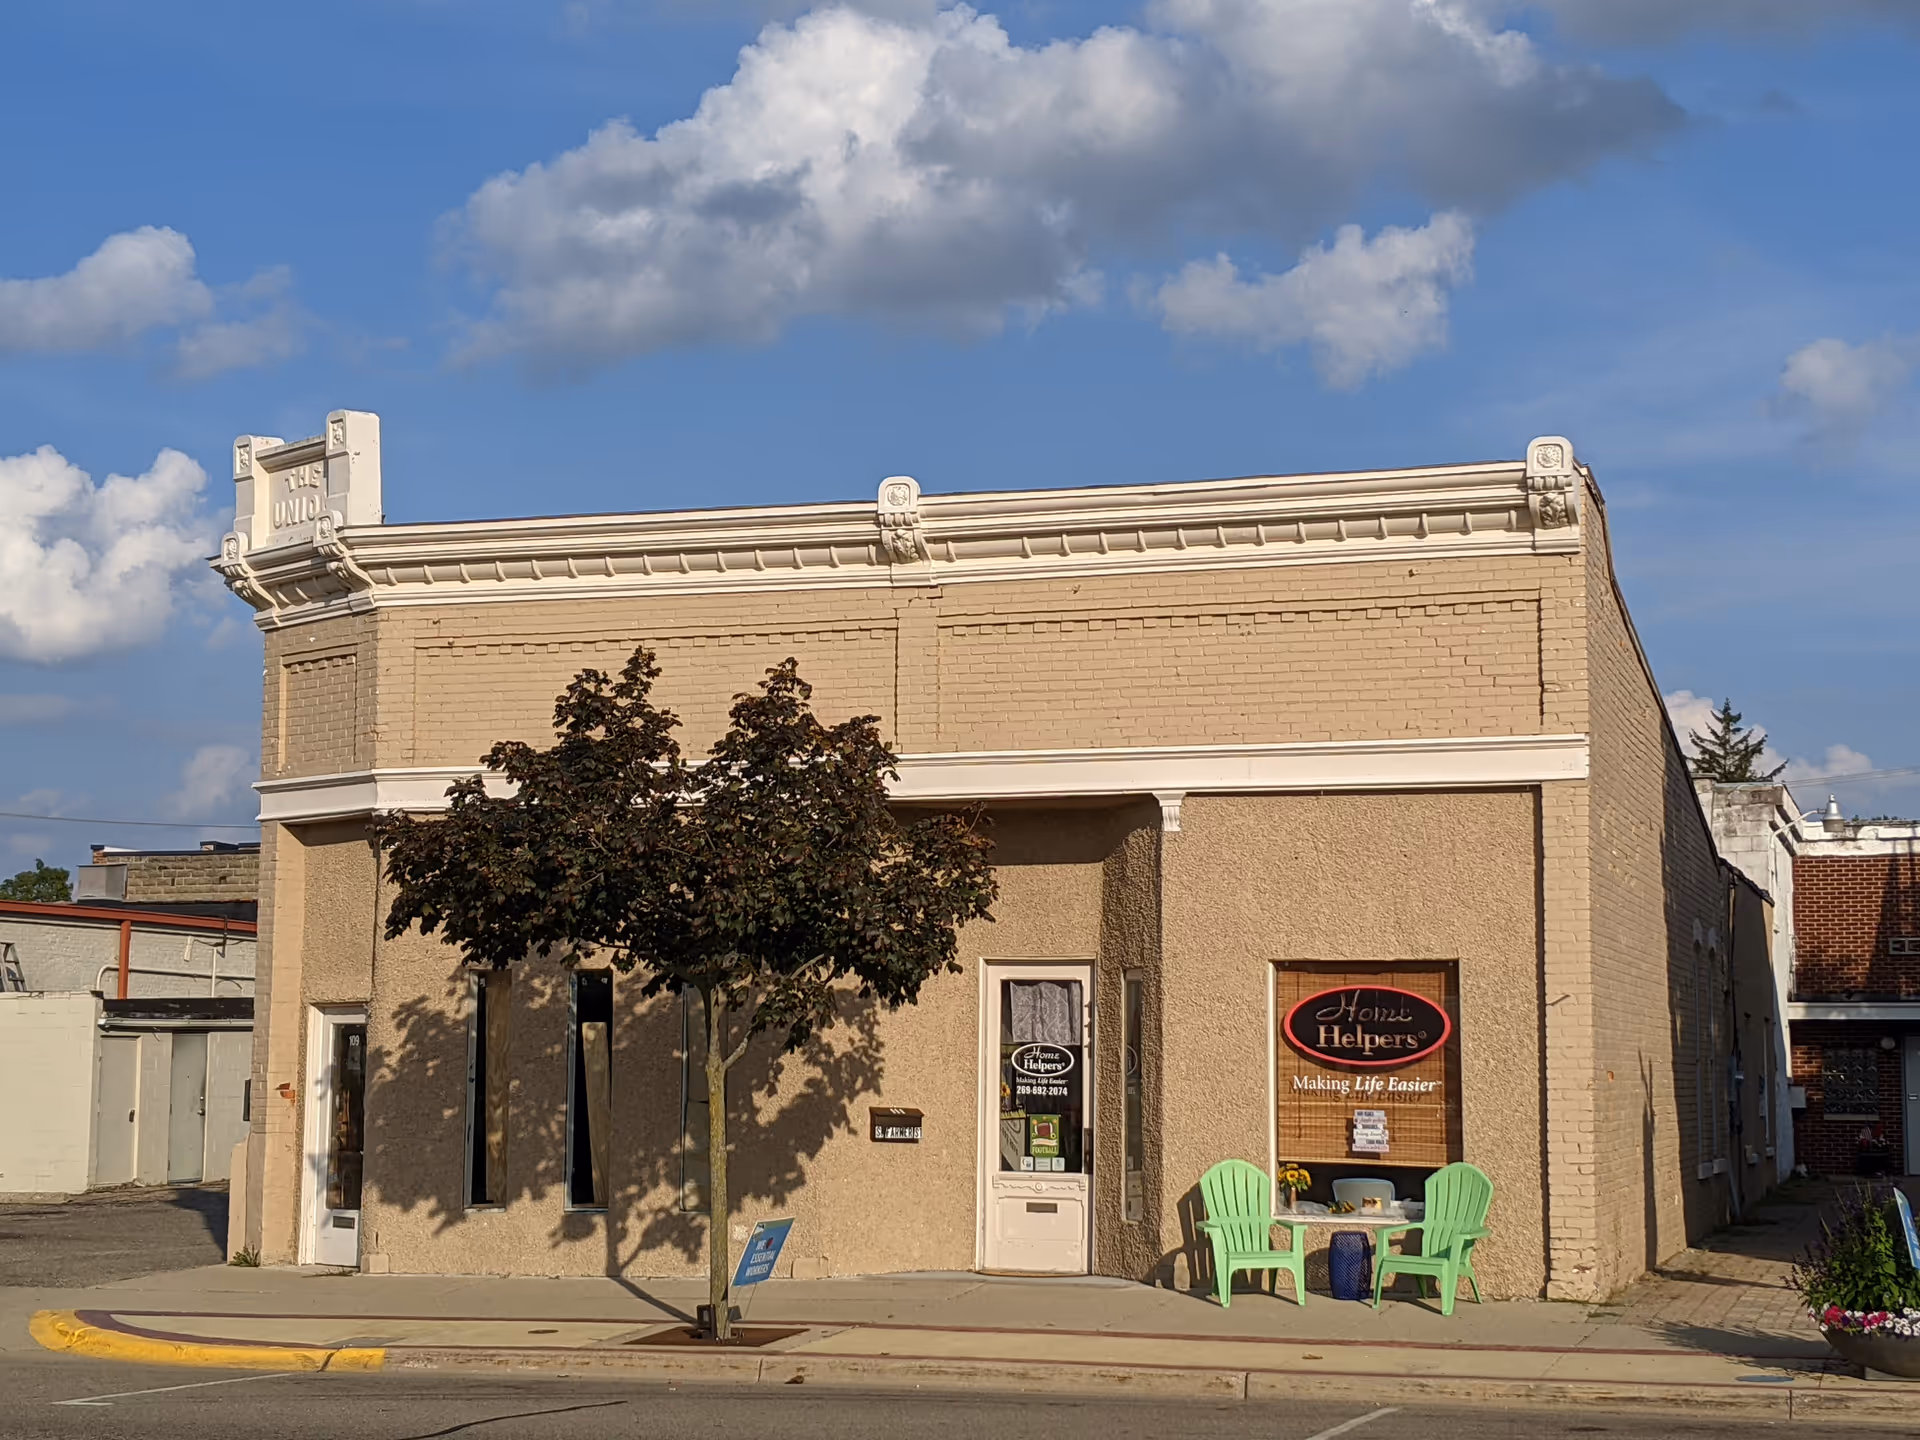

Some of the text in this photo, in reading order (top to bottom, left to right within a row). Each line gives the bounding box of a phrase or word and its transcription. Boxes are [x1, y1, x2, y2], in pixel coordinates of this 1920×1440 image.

[285, 465, 323, 493] THE
[273, 492, 327, 529] UNIO
[349, 1035, 360, 1046] 109
[1024, 1046, 1060, 1059] Home
[1016, 1077, 1036, 1085] Making
[1293, 1075, 1350, 1093] Making
[1354, 1075, 1384, 1094] Life
